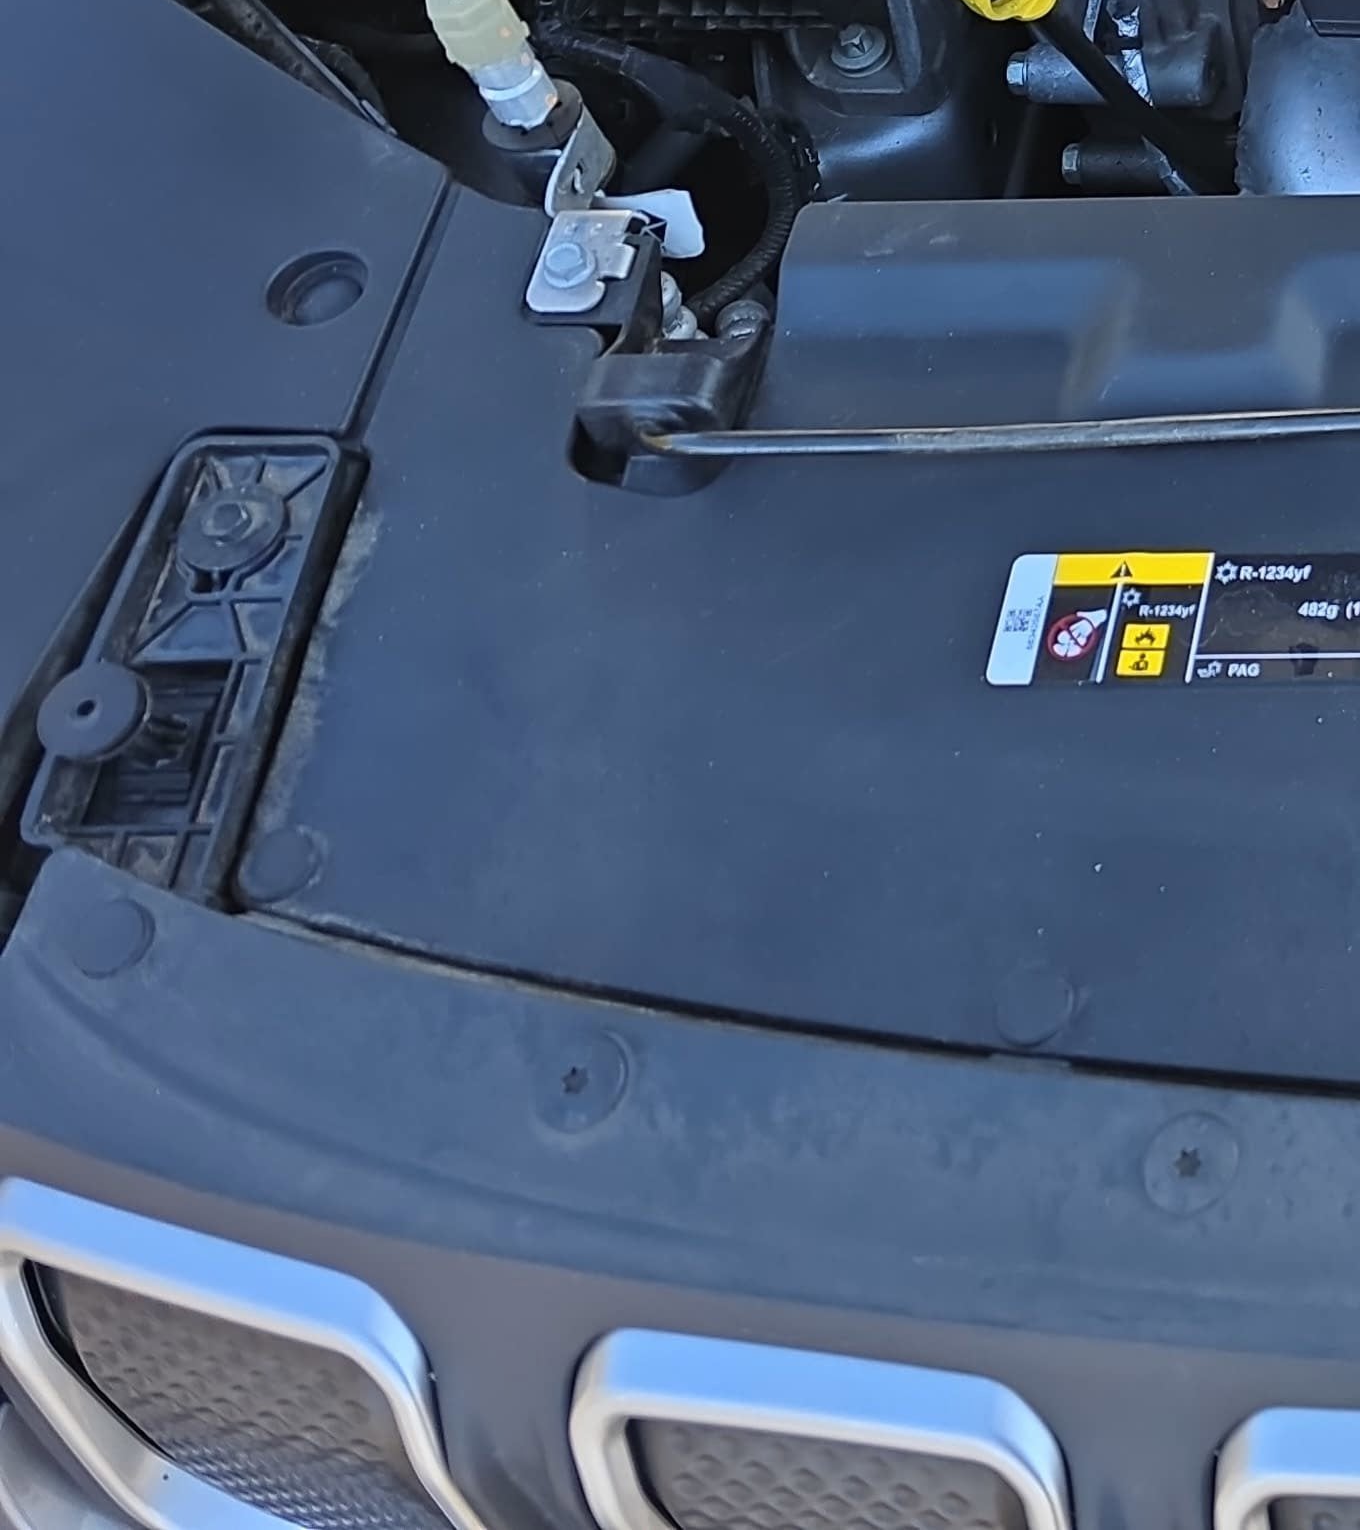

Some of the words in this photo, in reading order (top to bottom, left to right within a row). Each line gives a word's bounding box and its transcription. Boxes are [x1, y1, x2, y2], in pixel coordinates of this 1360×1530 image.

[1239, 563, 1312, 582] R-1234yf
[1298, 601, 1338, 619] 482g
[1226, 663, 1261, 678] PAG
